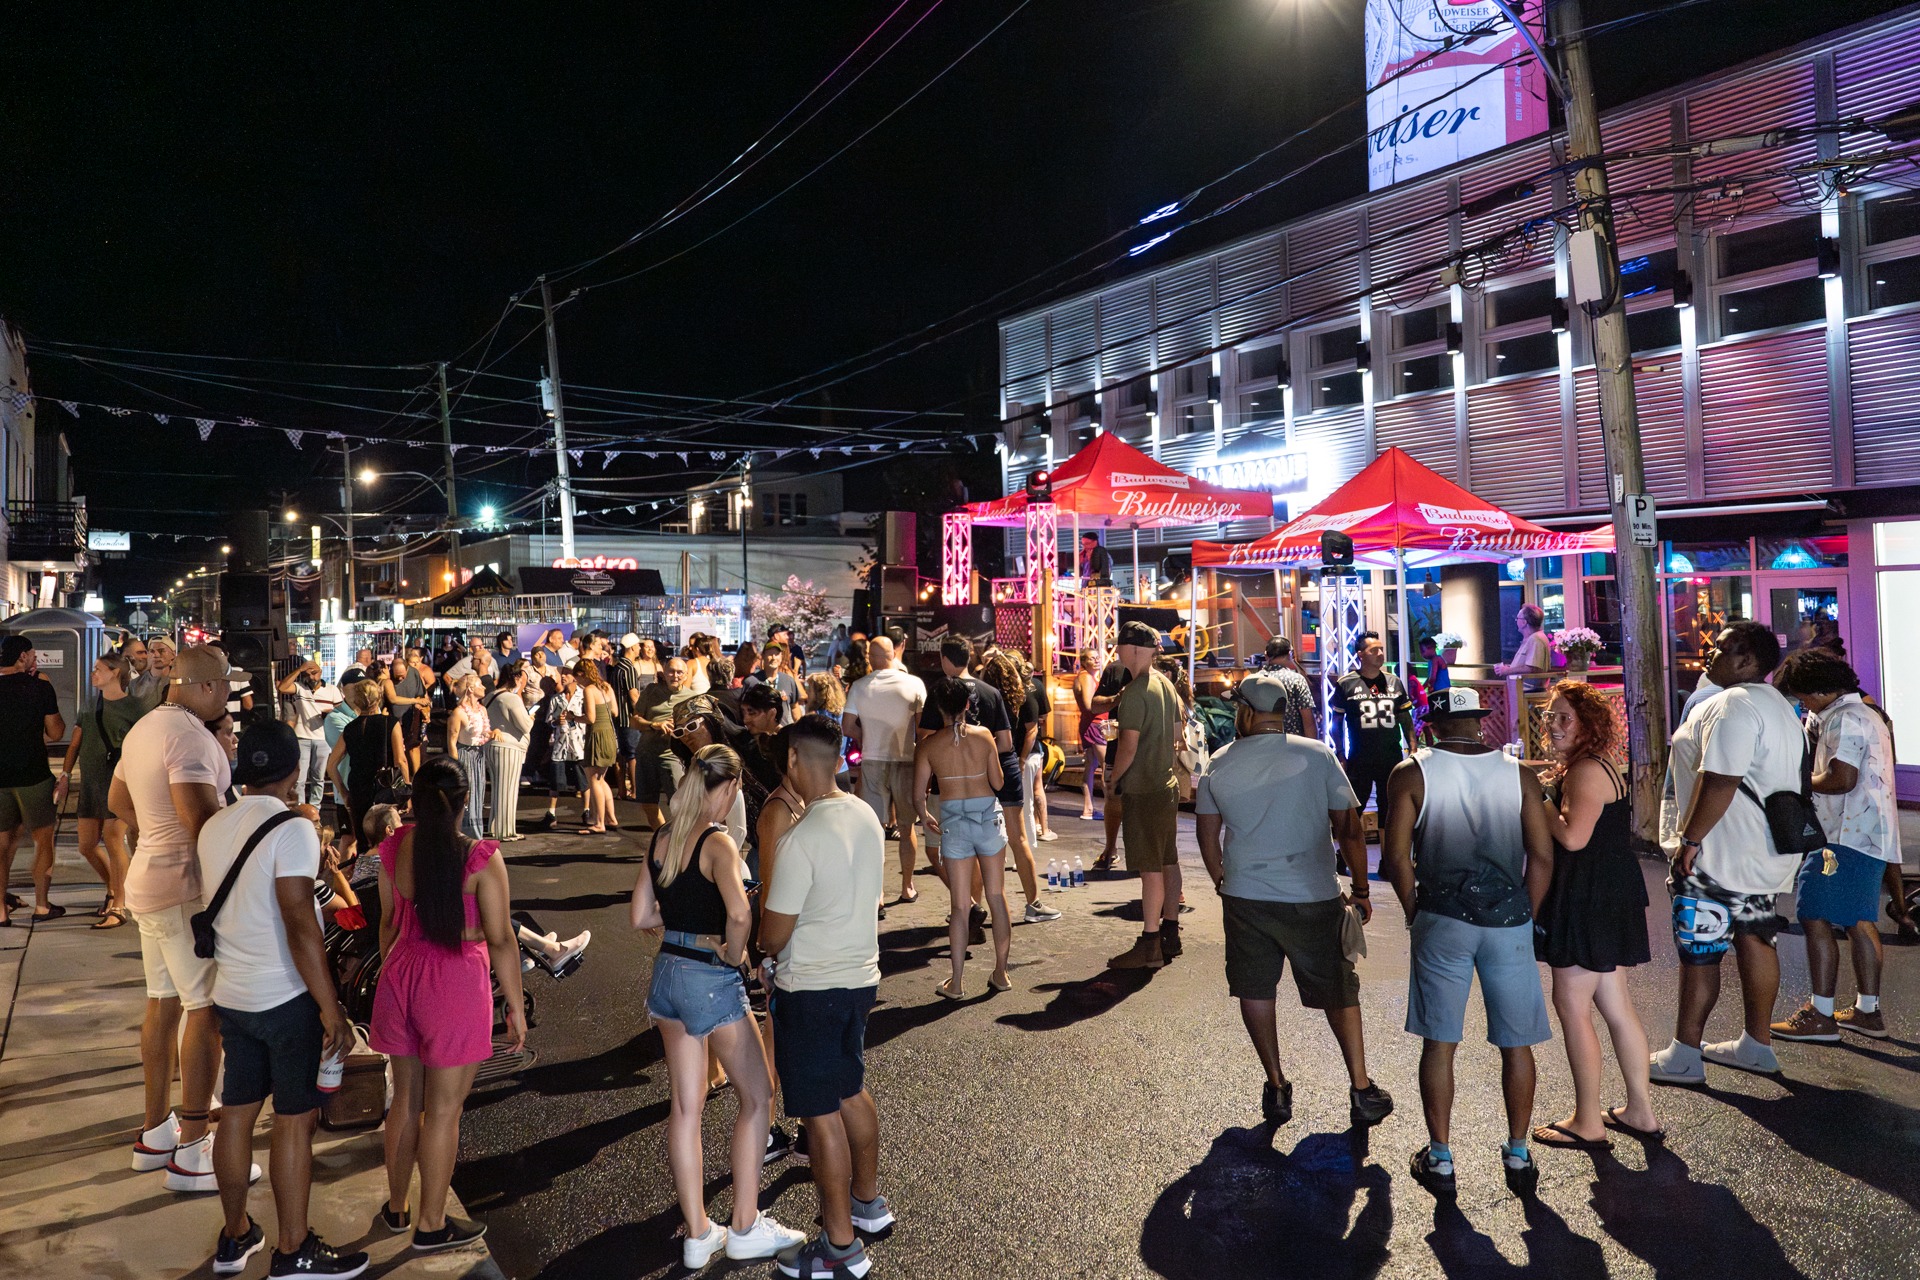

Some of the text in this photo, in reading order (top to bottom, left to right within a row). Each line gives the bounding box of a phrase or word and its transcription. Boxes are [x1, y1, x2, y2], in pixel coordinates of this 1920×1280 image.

[1428, 7, 1489, 19] BUDWEISER
[1433, 20, 1469, 33] LAGER
[1385, 59, 1434, 80] REGISTRED
[1107, 472, 1189, 488] Budweiser
[1111, 490, 1242, 516] Budweiser
[1635, 499, 1647, 517] P
[1414, 505, 1509, 525] Budweiser
[1440, 526, 1591, 551] Budweiser
[1359, 699, 1396, 729] 23
